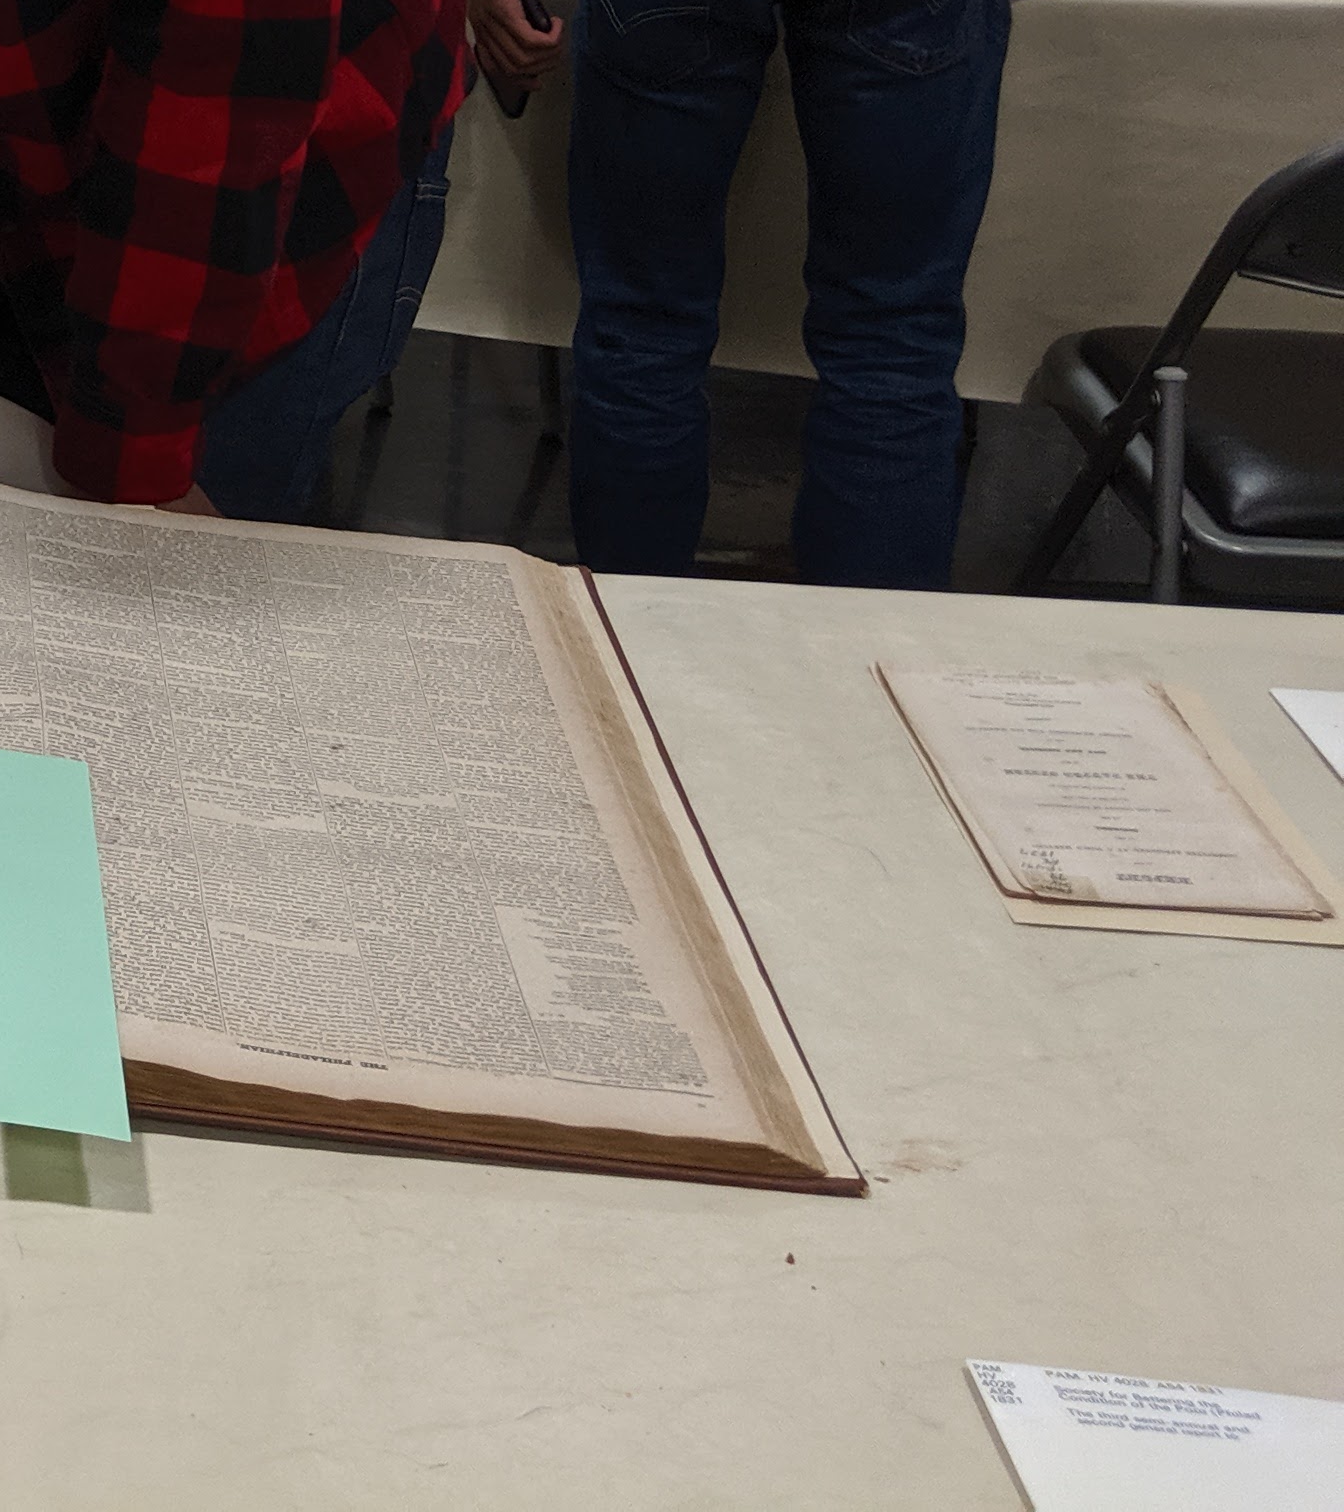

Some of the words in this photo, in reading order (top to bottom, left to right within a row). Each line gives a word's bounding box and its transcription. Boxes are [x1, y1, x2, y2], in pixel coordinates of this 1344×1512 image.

[972, 1362, 1001, 1372] PAM
[1044, 1370, 1080, 1380] PAM
[1108, 1390, 1127, 1400] for
[1058, 1393, 1127, 1407] Condition
[1130, 1401, 1145, 1409] of
[1066, 1408, 1093, 1418] The
[1097, 1410, 1129, 1421] third
